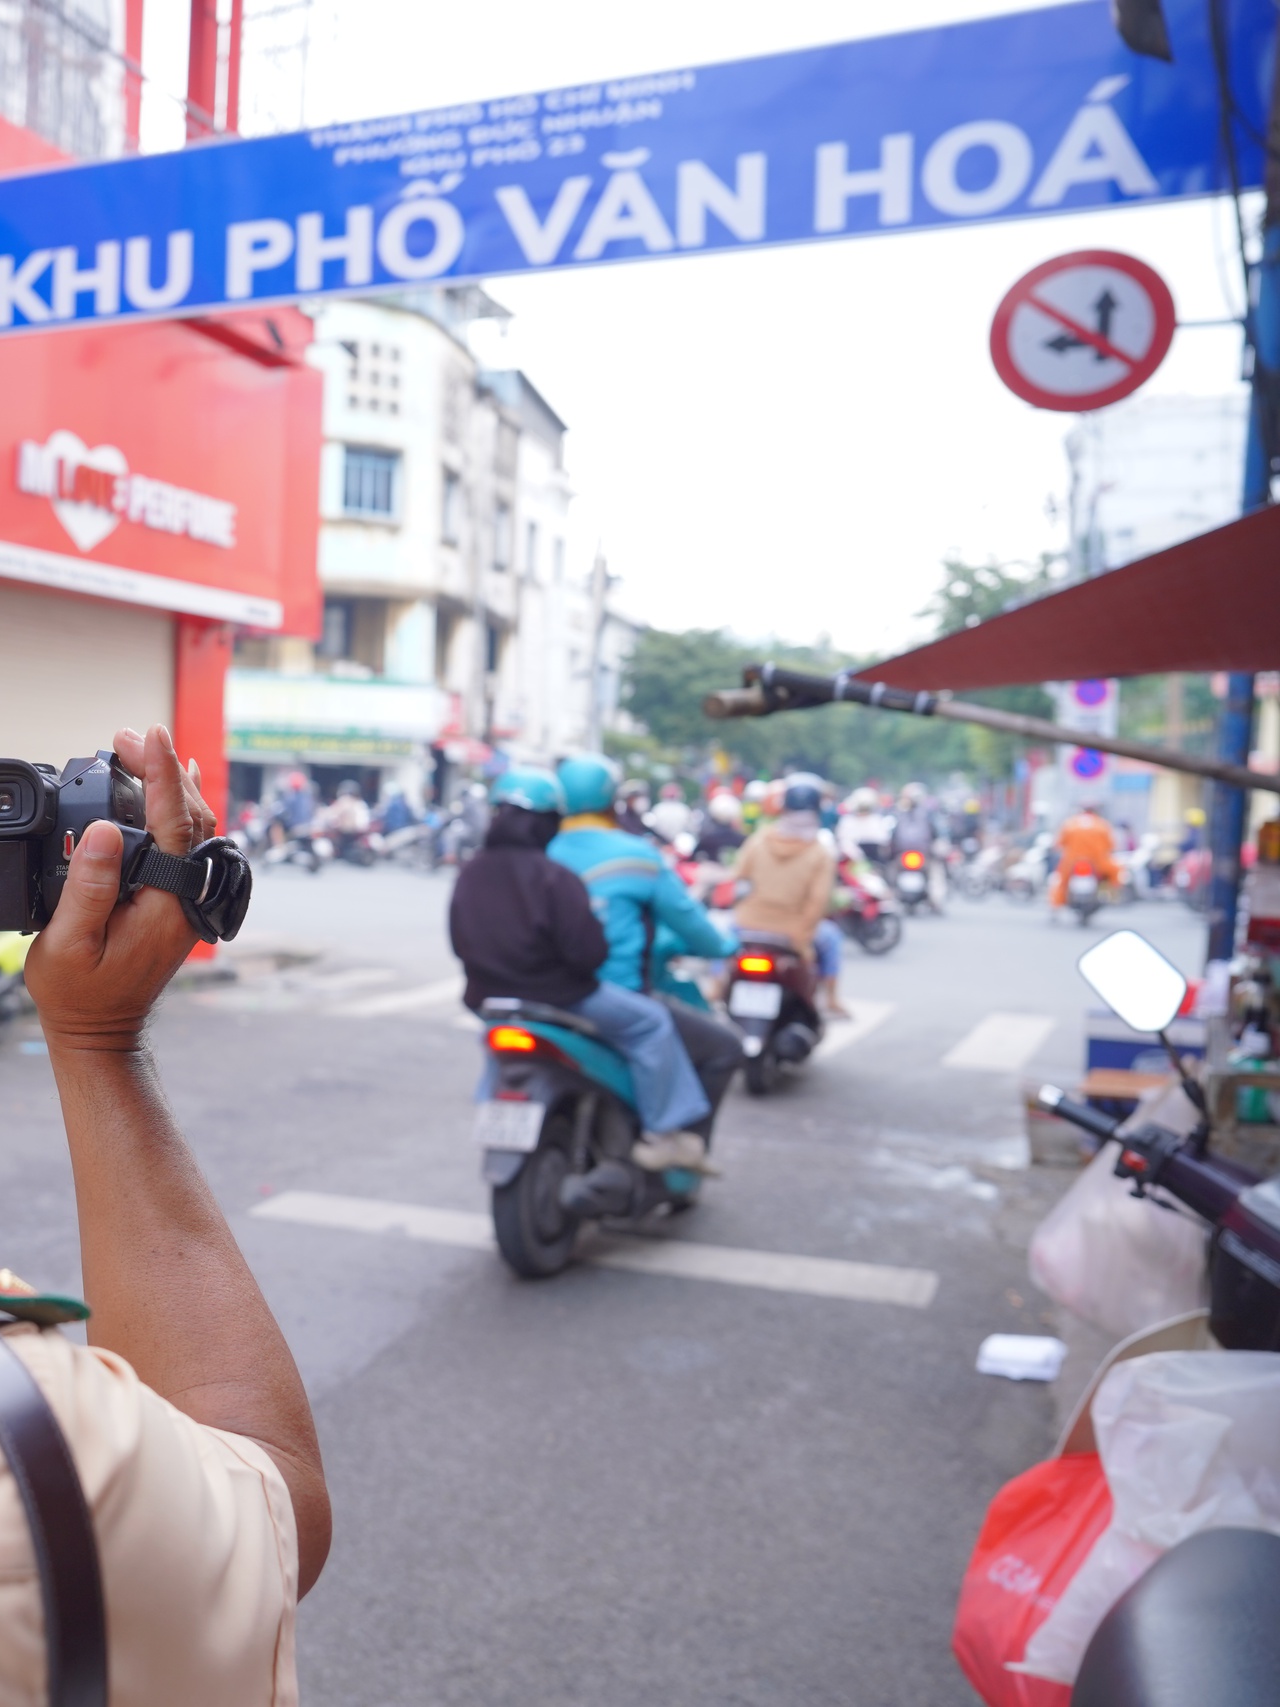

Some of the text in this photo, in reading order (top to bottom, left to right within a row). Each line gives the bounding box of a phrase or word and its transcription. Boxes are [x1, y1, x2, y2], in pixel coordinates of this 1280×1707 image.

[225, 172, 466, 300] PHỐ
[494, 146, 768, 267] VĂN
[814, 74, 1160, 233] HOÁ
